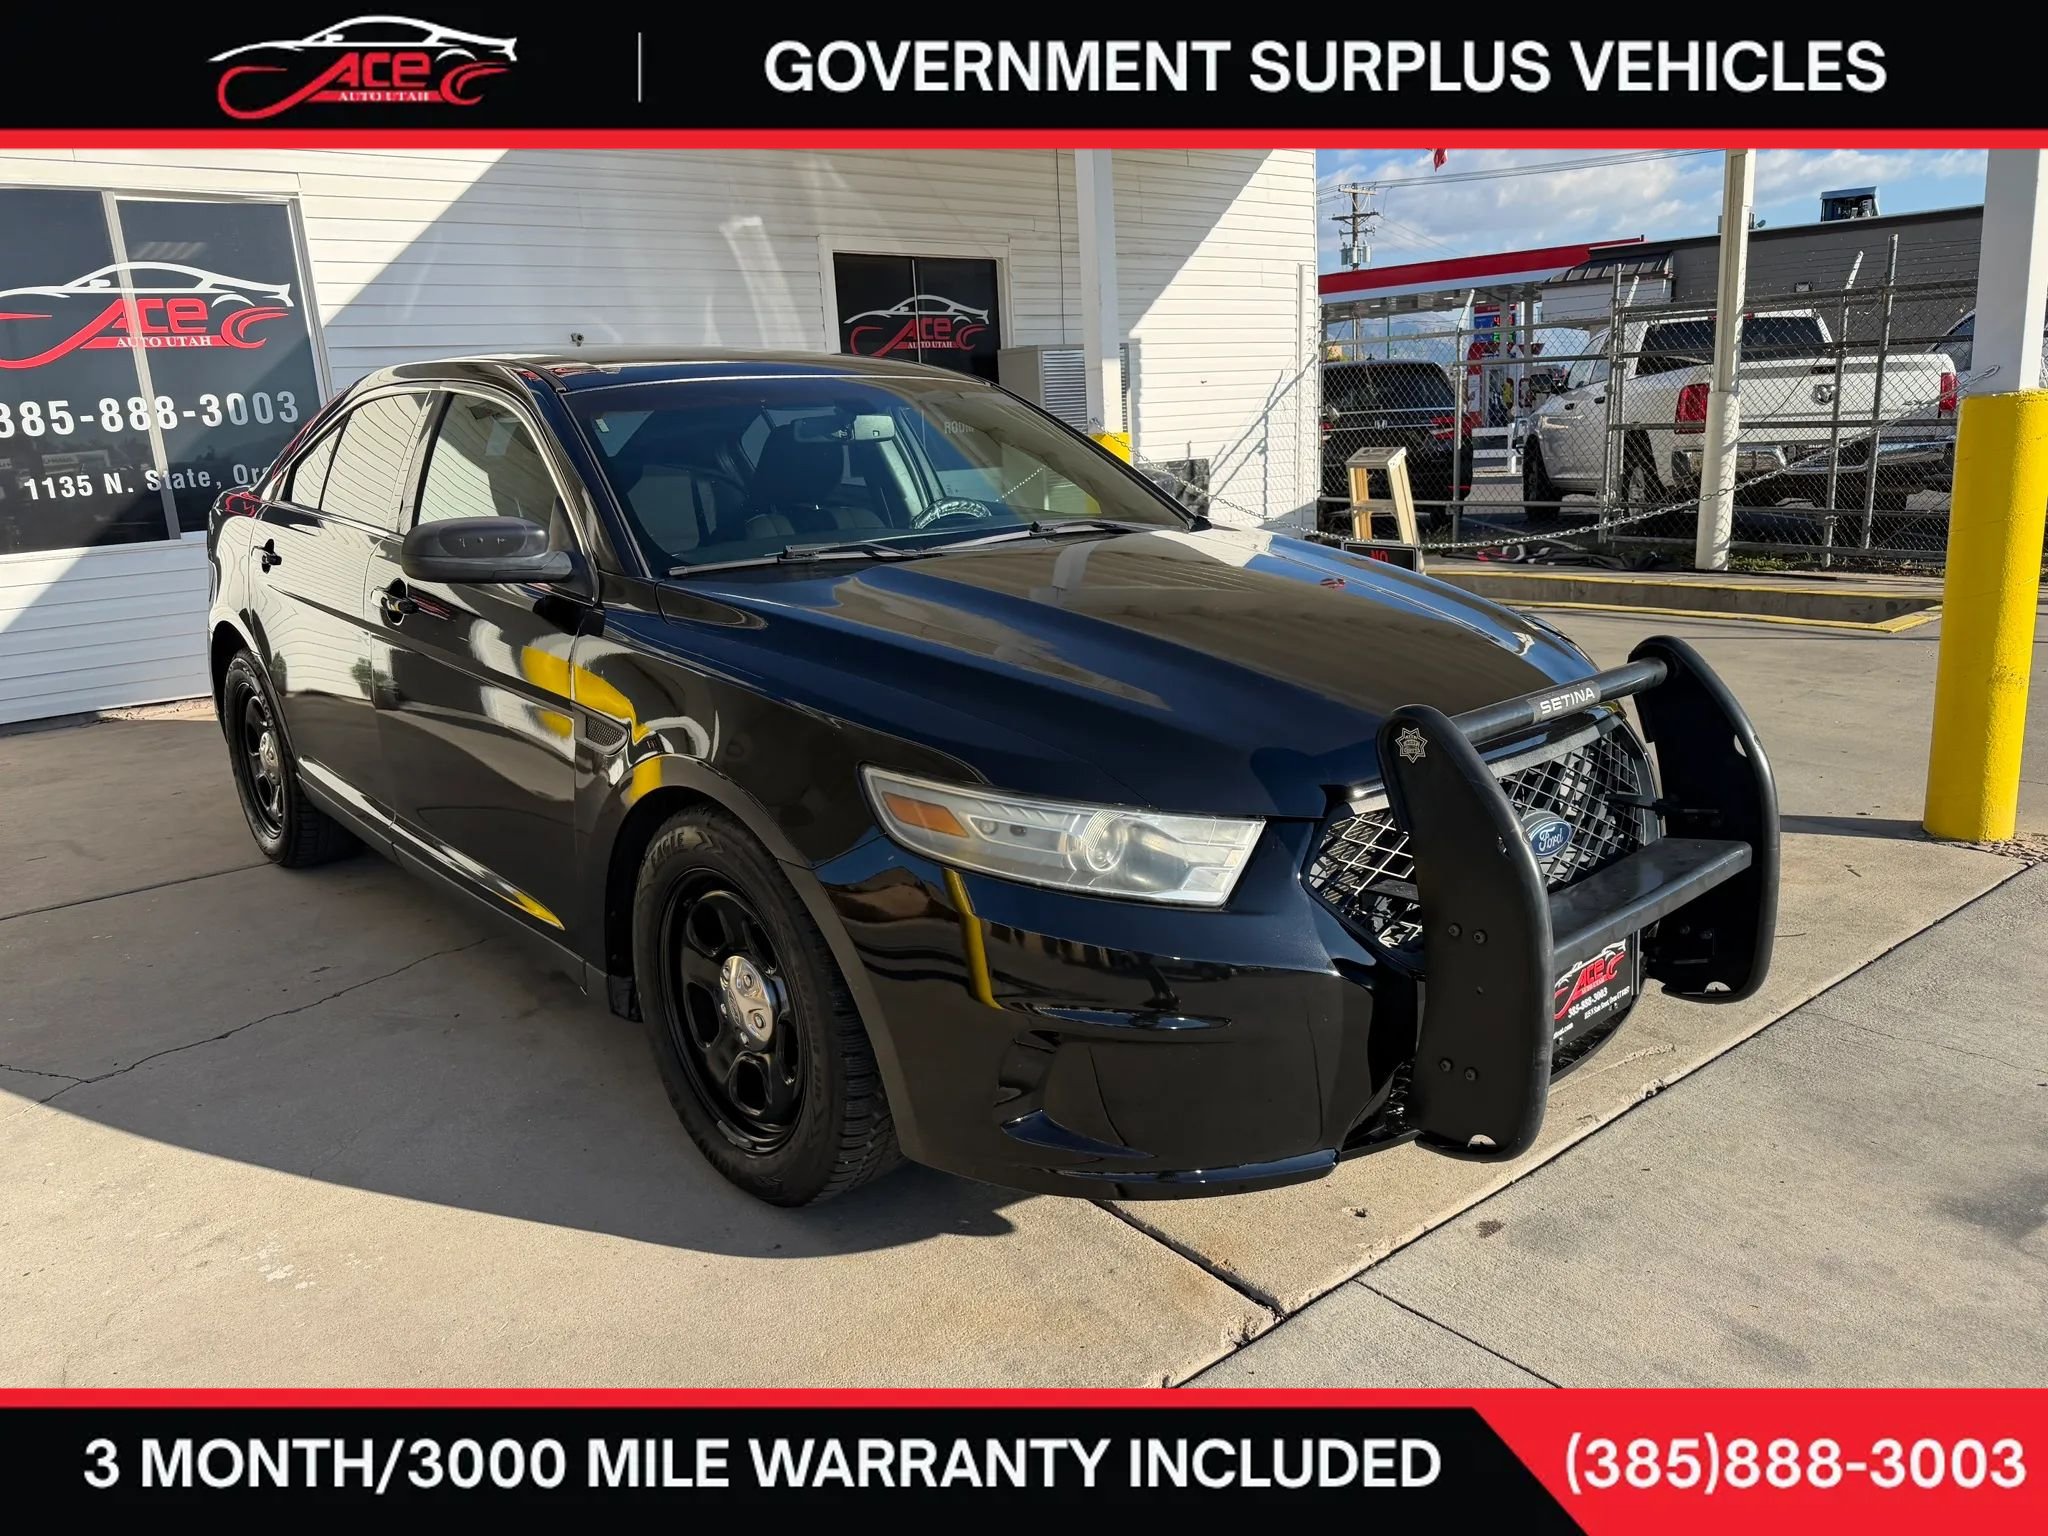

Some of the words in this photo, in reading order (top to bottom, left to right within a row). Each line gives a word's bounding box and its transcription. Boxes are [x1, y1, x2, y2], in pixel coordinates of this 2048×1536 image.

[116, 337, 161, 348] AUTO
[168, 335, 213, 348] UTAH
[931, 341, 952, 349] UTAH
[24, 475, 93, 500] 1135
[104, 472, 134, 494] N.
[1539, 687, 1596, 715] SETINA
[1538, 826, 1564, 851] Ford
